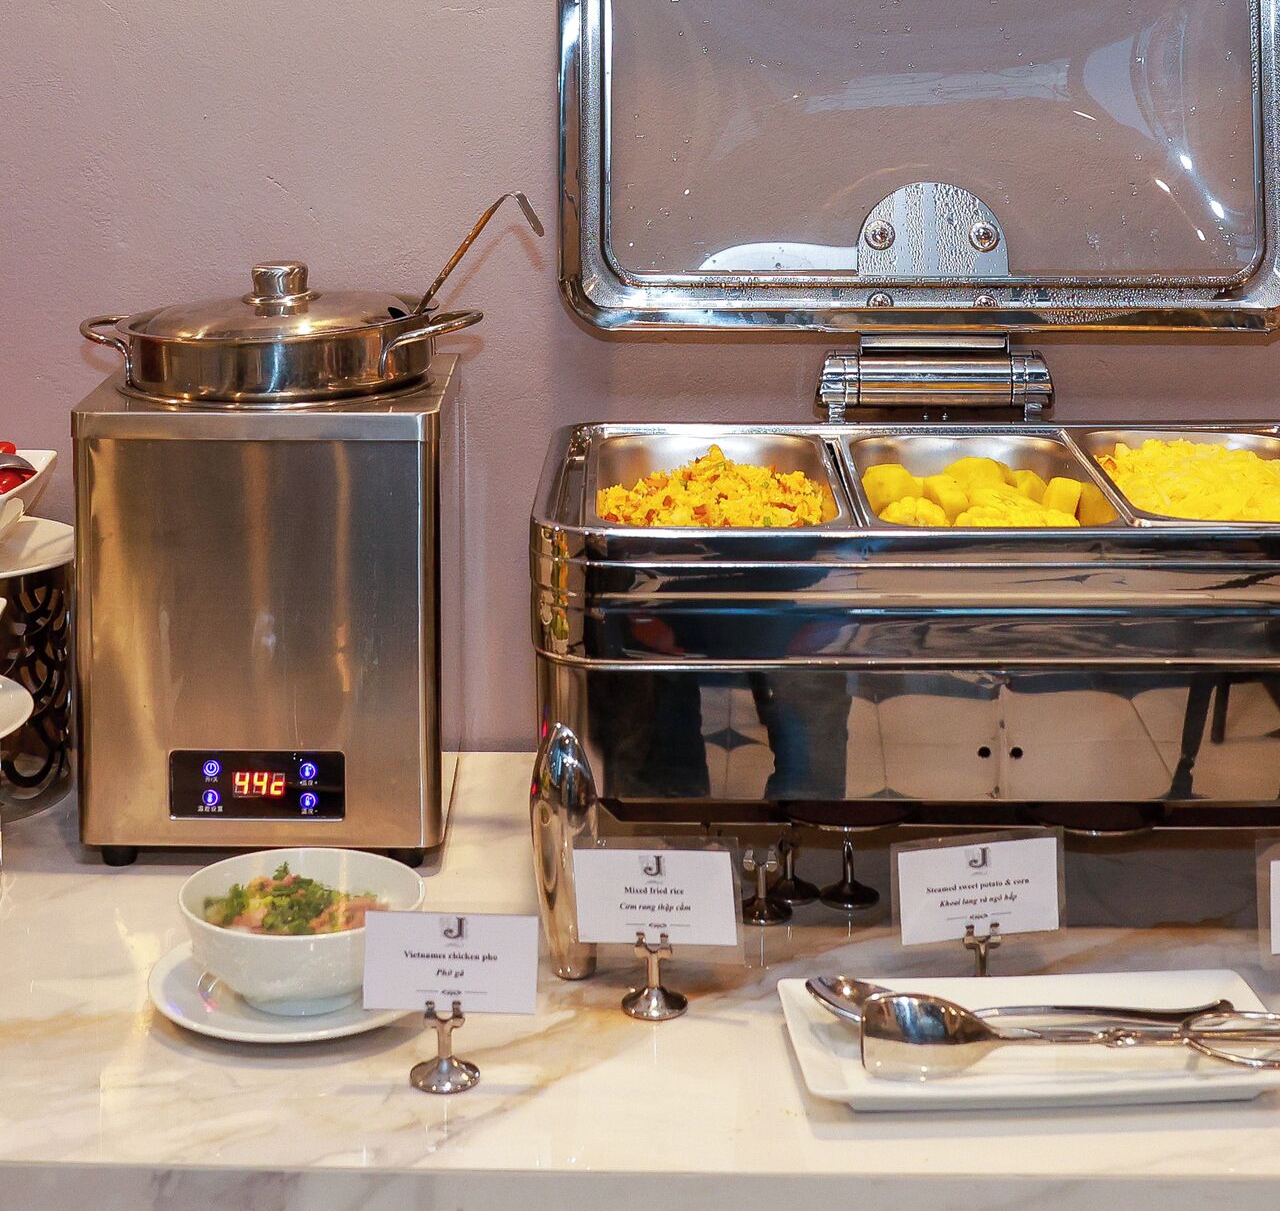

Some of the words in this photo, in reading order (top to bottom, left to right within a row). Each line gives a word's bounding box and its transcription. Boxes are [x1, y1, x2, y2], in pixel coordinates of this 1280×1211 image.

[968, 847, 988, 868] J
[643, 855, 662, 876] J
[624, 886, 647, 894] Mixed
[670, 887, 684, 895] rice
[926, 884, 956, 893] Steamed
[980, 881, 1002, 890] potato
[939, 899, 960, 908] Khoai
[962, 897, 977, 905] lang
[444, 917, 465, 939] J
[448, 952, 480, 960] chicken
[482, 953, 498, 962] pho
